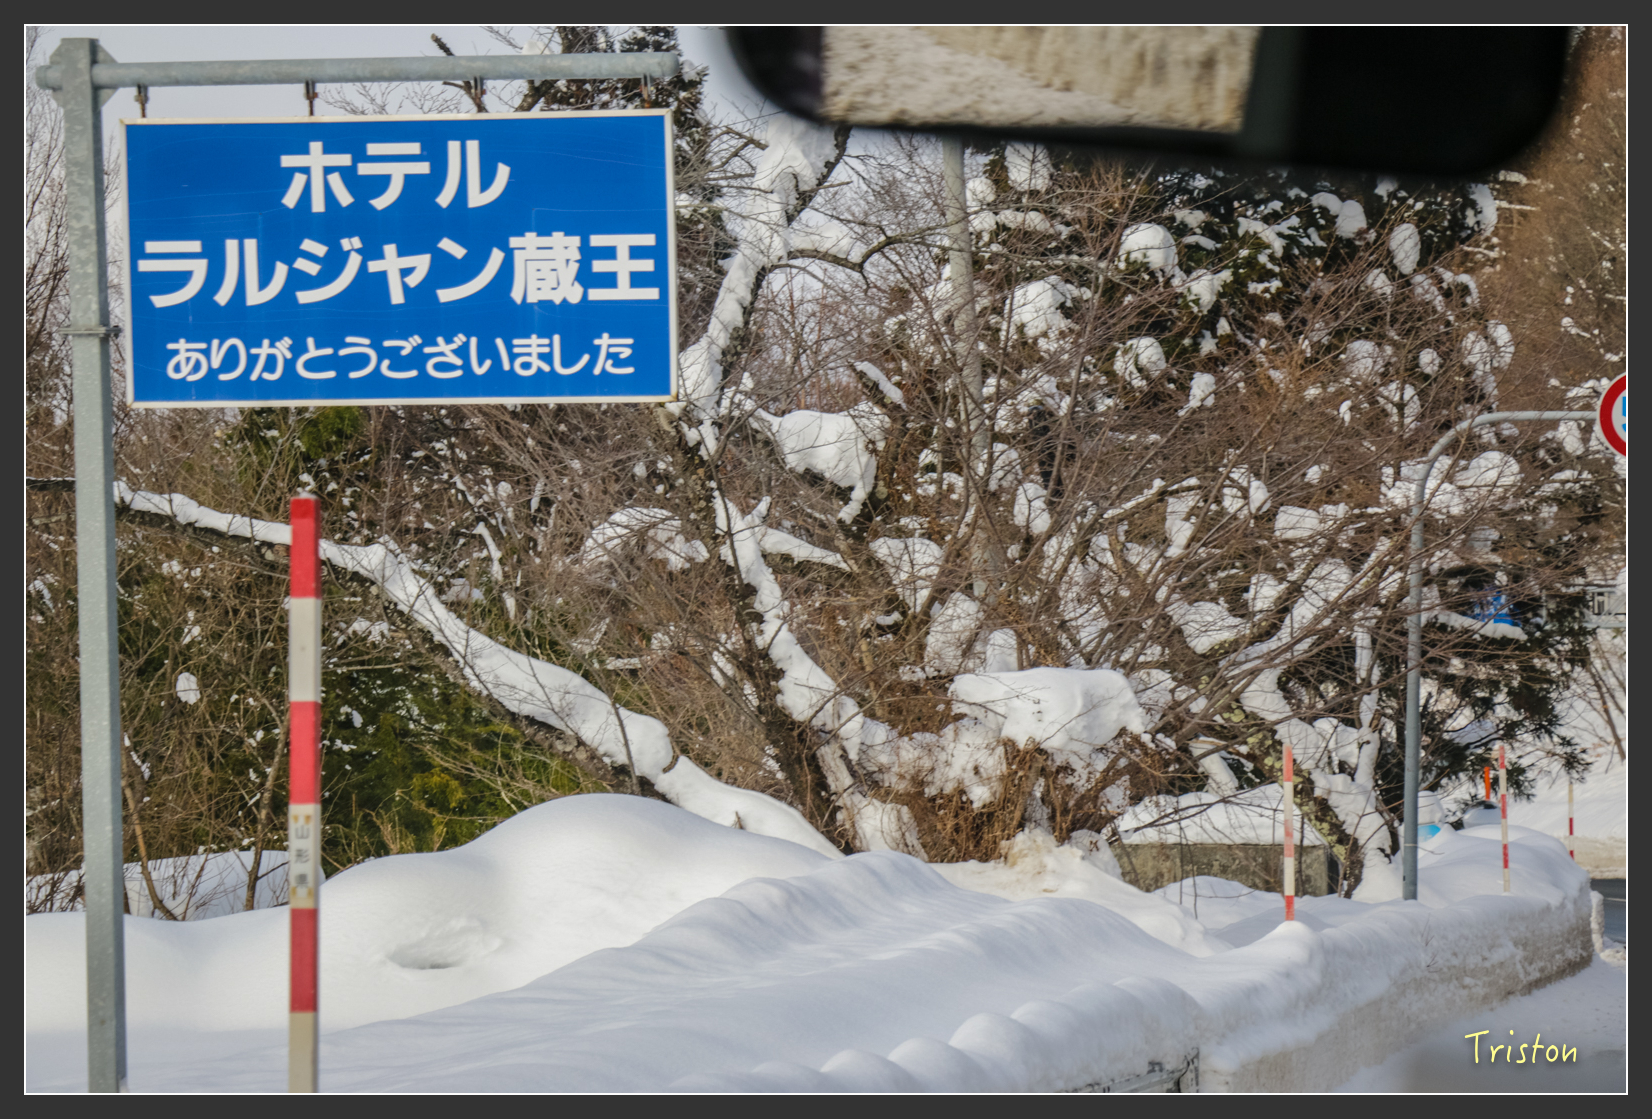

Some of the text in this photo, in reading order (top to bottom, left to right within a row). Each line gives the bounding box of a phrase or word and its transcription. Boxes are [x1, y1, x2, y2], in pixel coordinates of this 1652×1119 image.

[280, 140, 511, 213] ホテル
[137, 231, 660, 308] ラルジャン蔵王
[165, 333, 635, 382] ありがとうございました
